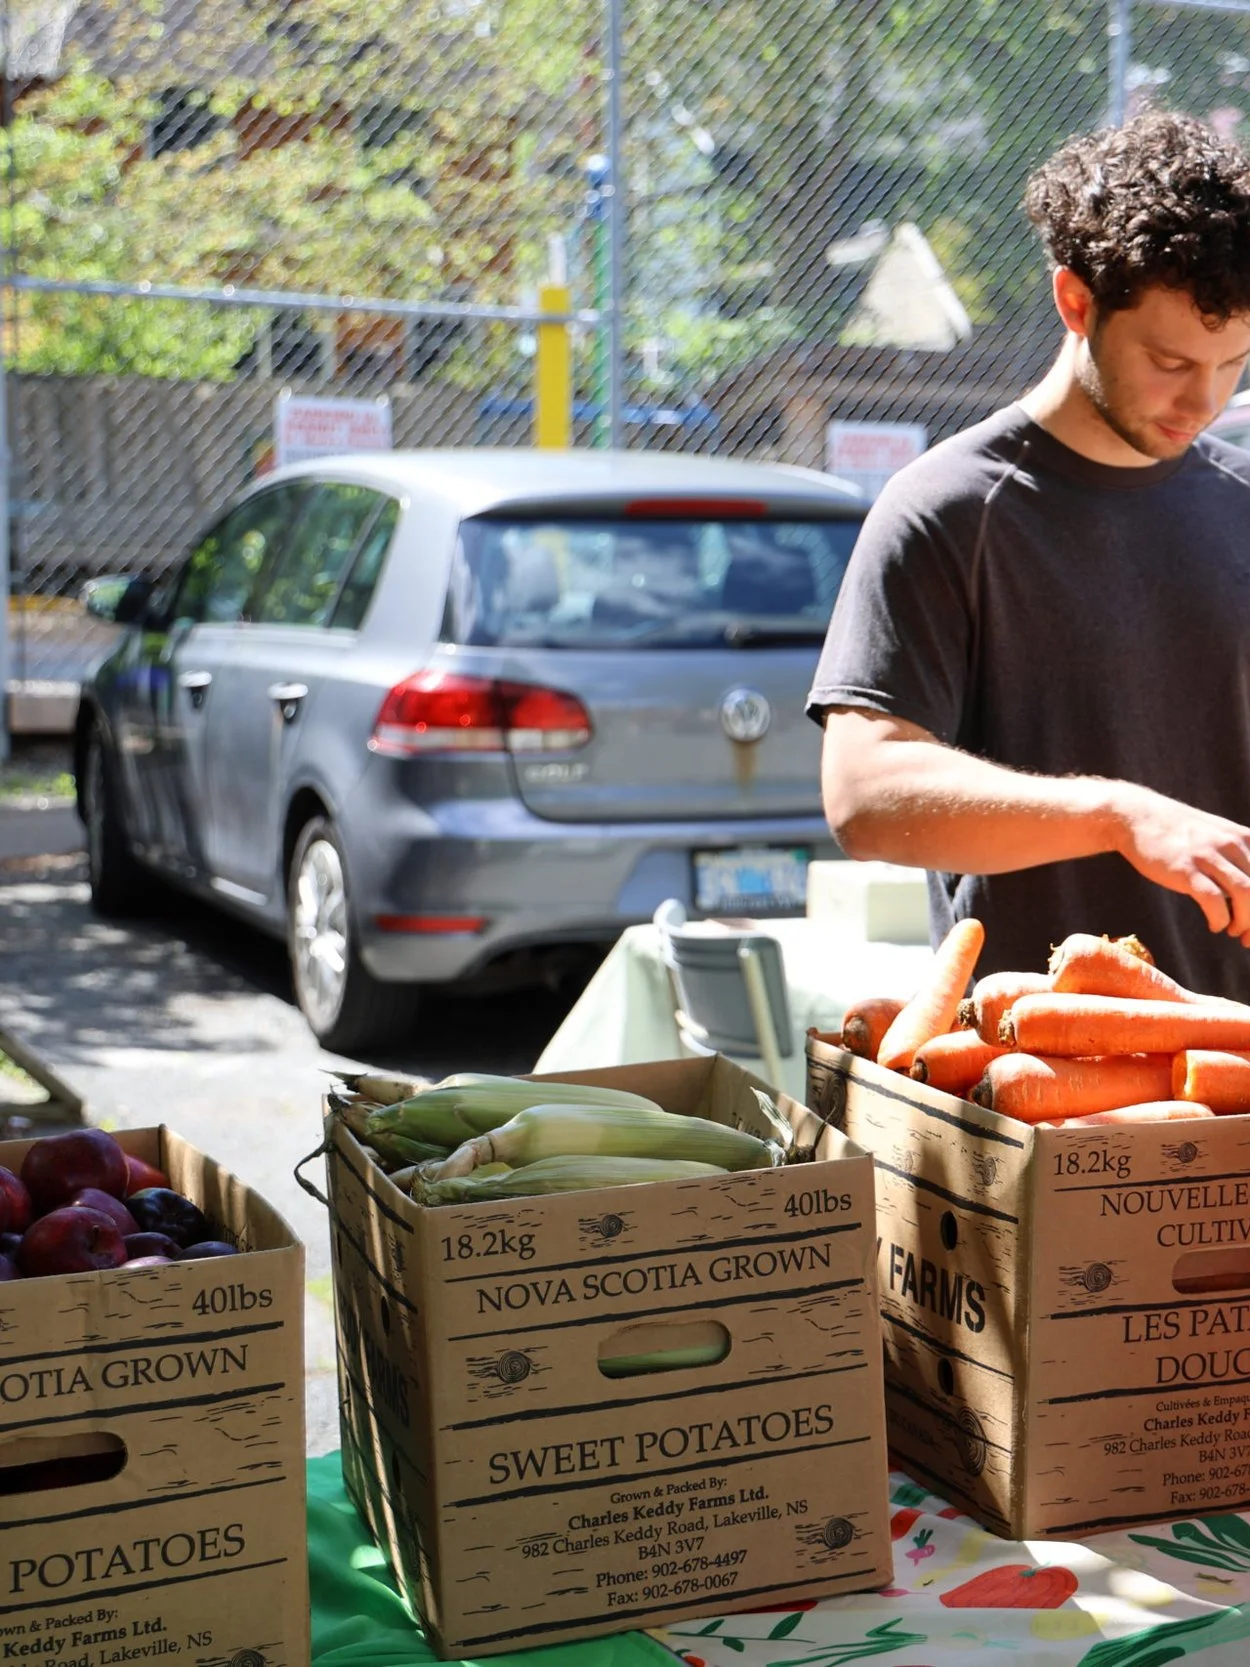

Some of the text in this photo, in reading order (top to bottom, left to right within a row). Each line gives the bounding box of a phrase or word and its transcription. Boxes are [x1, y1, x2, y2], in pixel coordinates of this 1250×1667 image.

[1053, 1149, 1132, 1179] 18.2kg
[784, 1188, 851, 1218] 40lbs
[441, 1230, 535, 1262] 18.2kg
[476, 1279, 576, 1314] NOVA
[583, 1261, 703, 1300] SCOTIA
[709, 1243, 832, 1283] GROWN
[889, 1242, 986, 1334] FARMS
[192, 1284, 273, 1316] 40lbs
[1123, 1308, 1181, 1344] LES
[101, 1344, 249, 1389] GROWN
[1143, 1417, 1193, 1432] Charles
[1197, 1410, 1240, 1427] Keddy
[1155, 1399, 1200, 1412] Cultivées
[1202, 1398, 1212, 1407] &
[489, 1437, 623, 1484] SWEET
[636, 1404, 834, 1463] POTATOES
[1103, 1442, 1126, 1456] 982
[1129, 1435, 1176, 1453] Charles
[1180, 1429, 1221, 1448] Keddy
[1199, 1448, 1226, 1463] B4N
[610, 1476, 728, 1504] Grown & Packed By:
[1162, 1470, 1206, 1487] Phone:
[568, 1487, 769, 1532] Charles Keddy Farms Ltd.
[1170, 1490, 1196, 1505] Fax:
[521, 1500, 808, 1560] 982 Charles Keddy Road, Lakeville, NS
[9, 1523, 246, 1594] POTATOES
[638, 1537, 705, 1561] B4N 3V7
[595, 1550, 748, 1589] Phone: 902-678-4497
[607, 1571, 738, 1607] Fax: 902-678-0067
[29, 1621, 42, 1633] &
[45, 1611, 94, 1630] Packed
[97, 1608, 118, 1624] By:
[3, 1617, 168, 1658] Keddy Farms Ltd.
[100, 1638, 182, 1667] Lakeville,
[187, 1631, 213, 1650] NS
